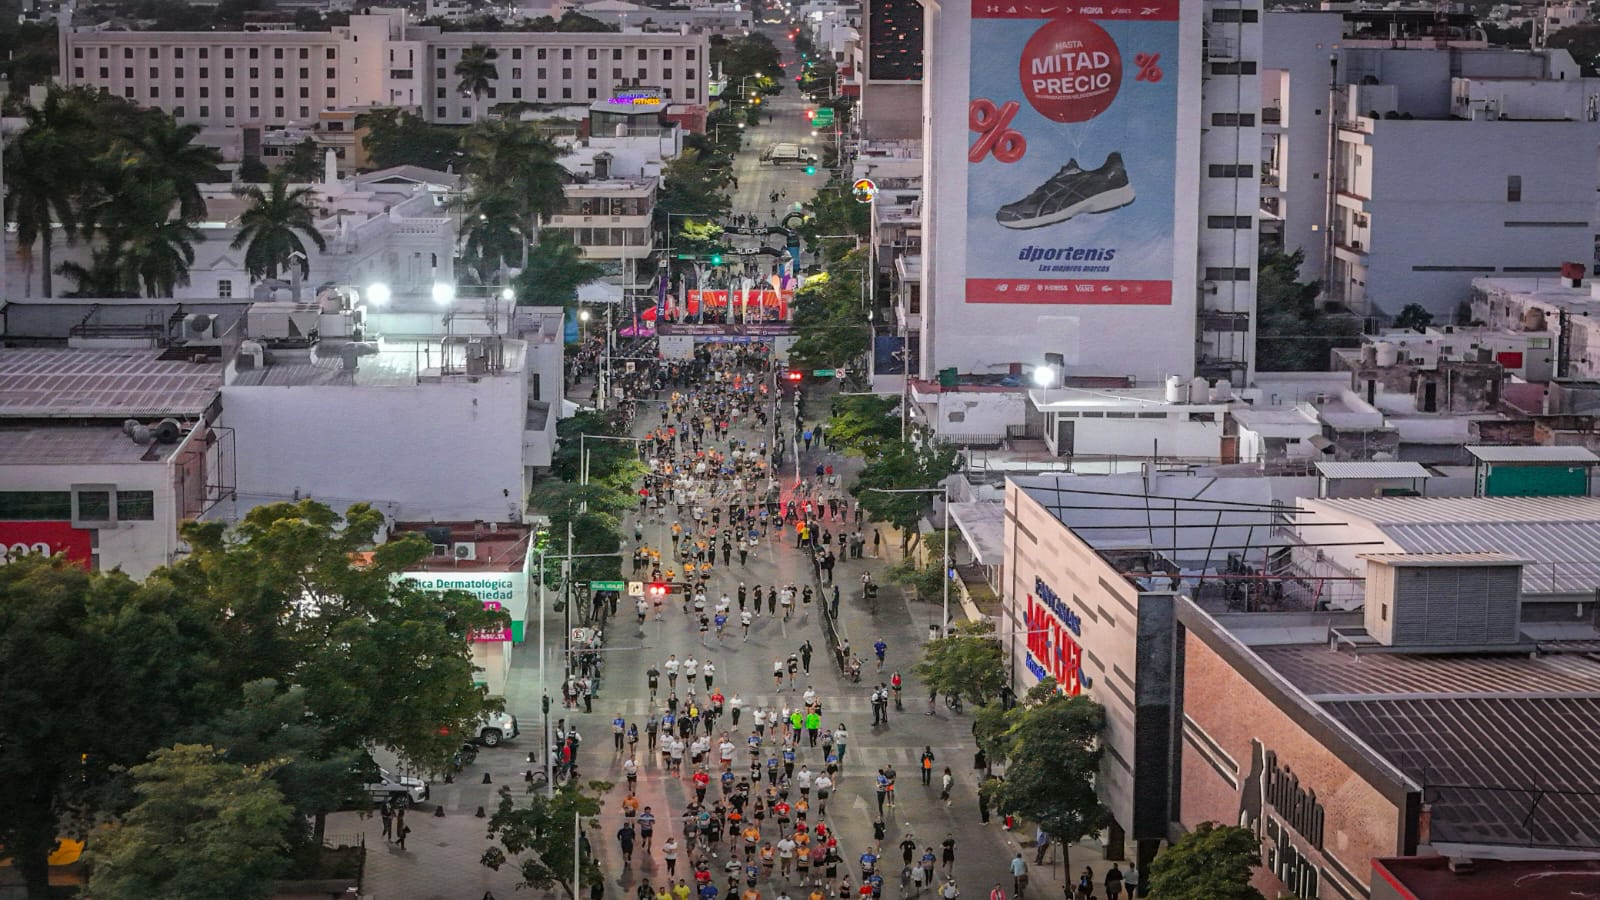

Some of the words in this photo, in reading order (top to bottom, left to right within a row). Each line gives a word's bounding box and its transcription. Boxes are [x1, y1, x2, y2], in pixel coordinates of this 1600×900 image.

[1055, 40, 1083, 50] HASTA
[1031, 51, 1110, 75] MITAD
[1032, 72, 1111, 94] PRECIO
[1018, 245, 1116, 262] dportenis
[437, 579, 513, 590] Dermatológica
